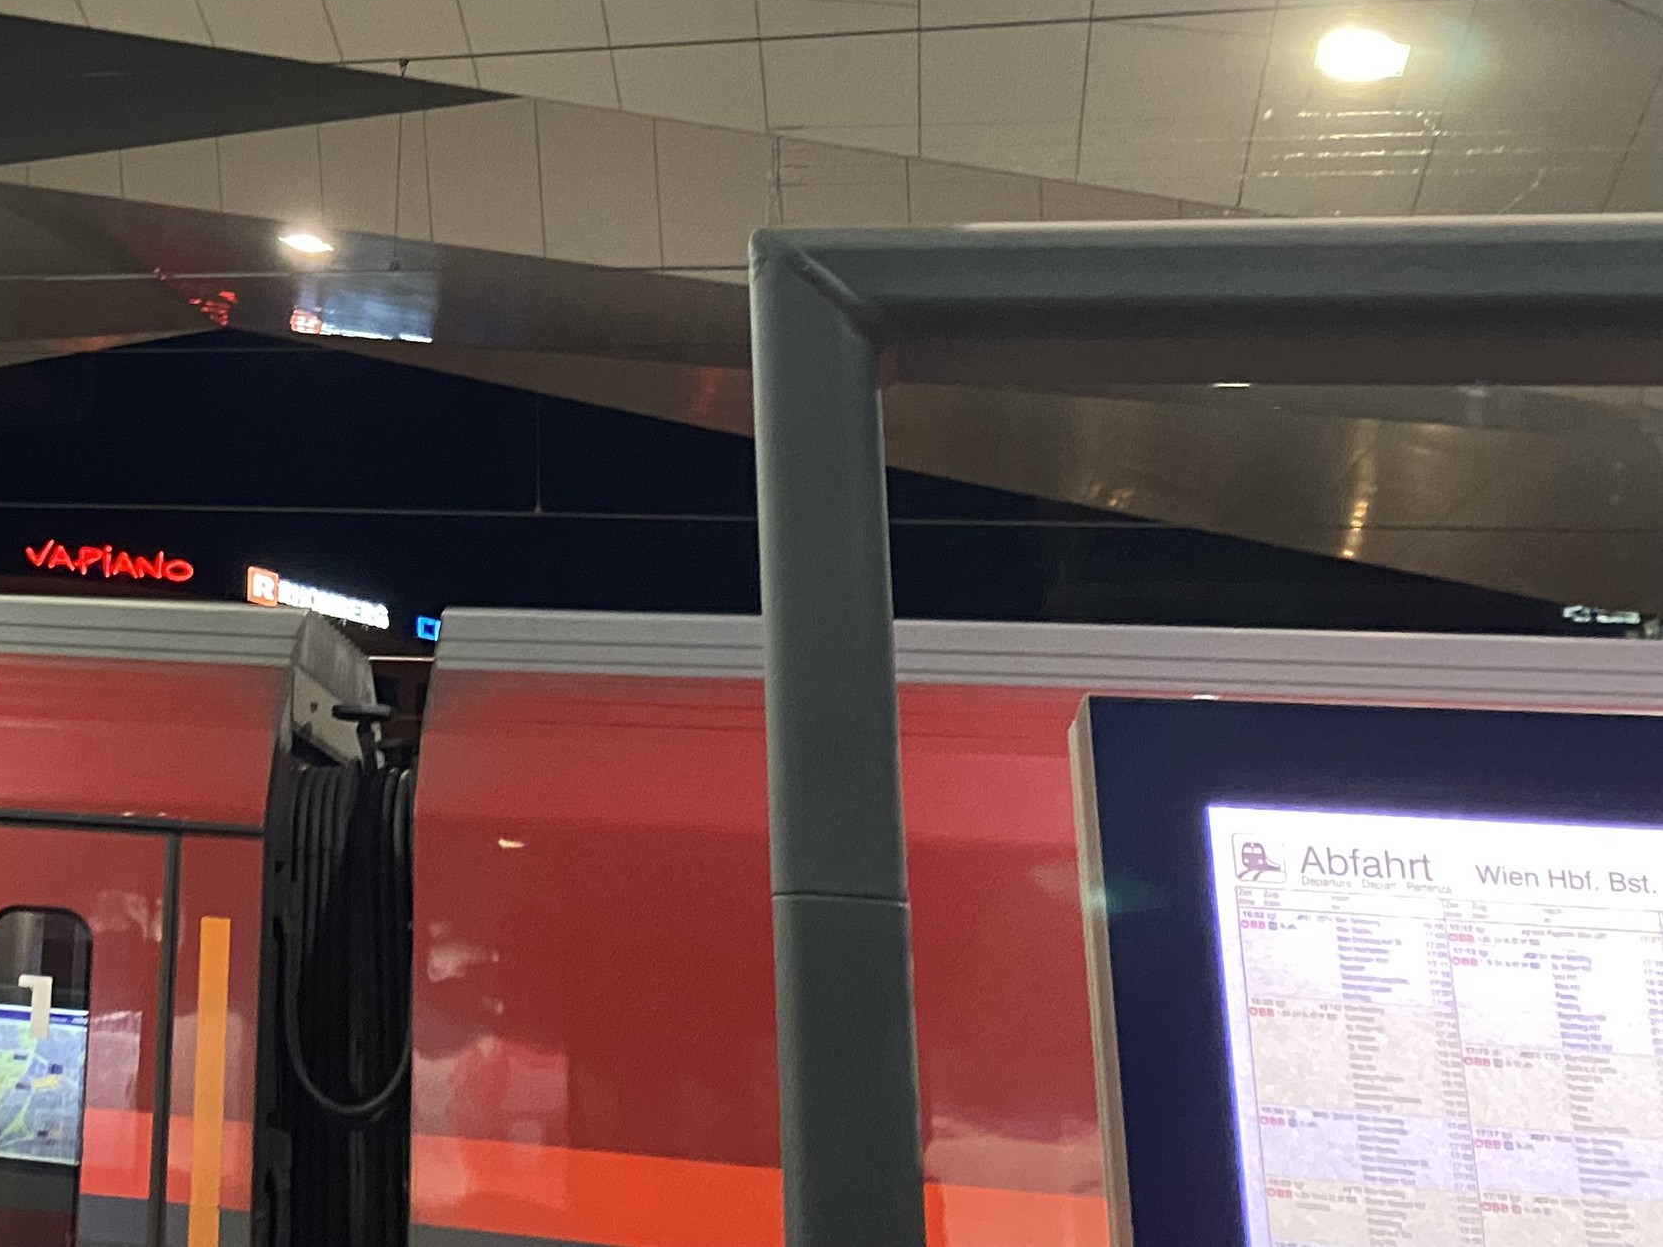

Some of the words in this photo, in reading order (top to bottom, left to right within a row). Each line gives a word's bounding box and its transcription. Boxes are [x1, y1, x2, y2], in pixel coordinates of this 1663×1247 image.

[1300, 845, 1434, 882] Abfahrt
[1474, 864, 1540, 887] Wien
[1547, 869, 1600, 891] Hbf.
[1608, 871, 1657, 894] Bst.
[1301, 876, 1352, 889] Departure
[18, 974, 53, 1039] 1
